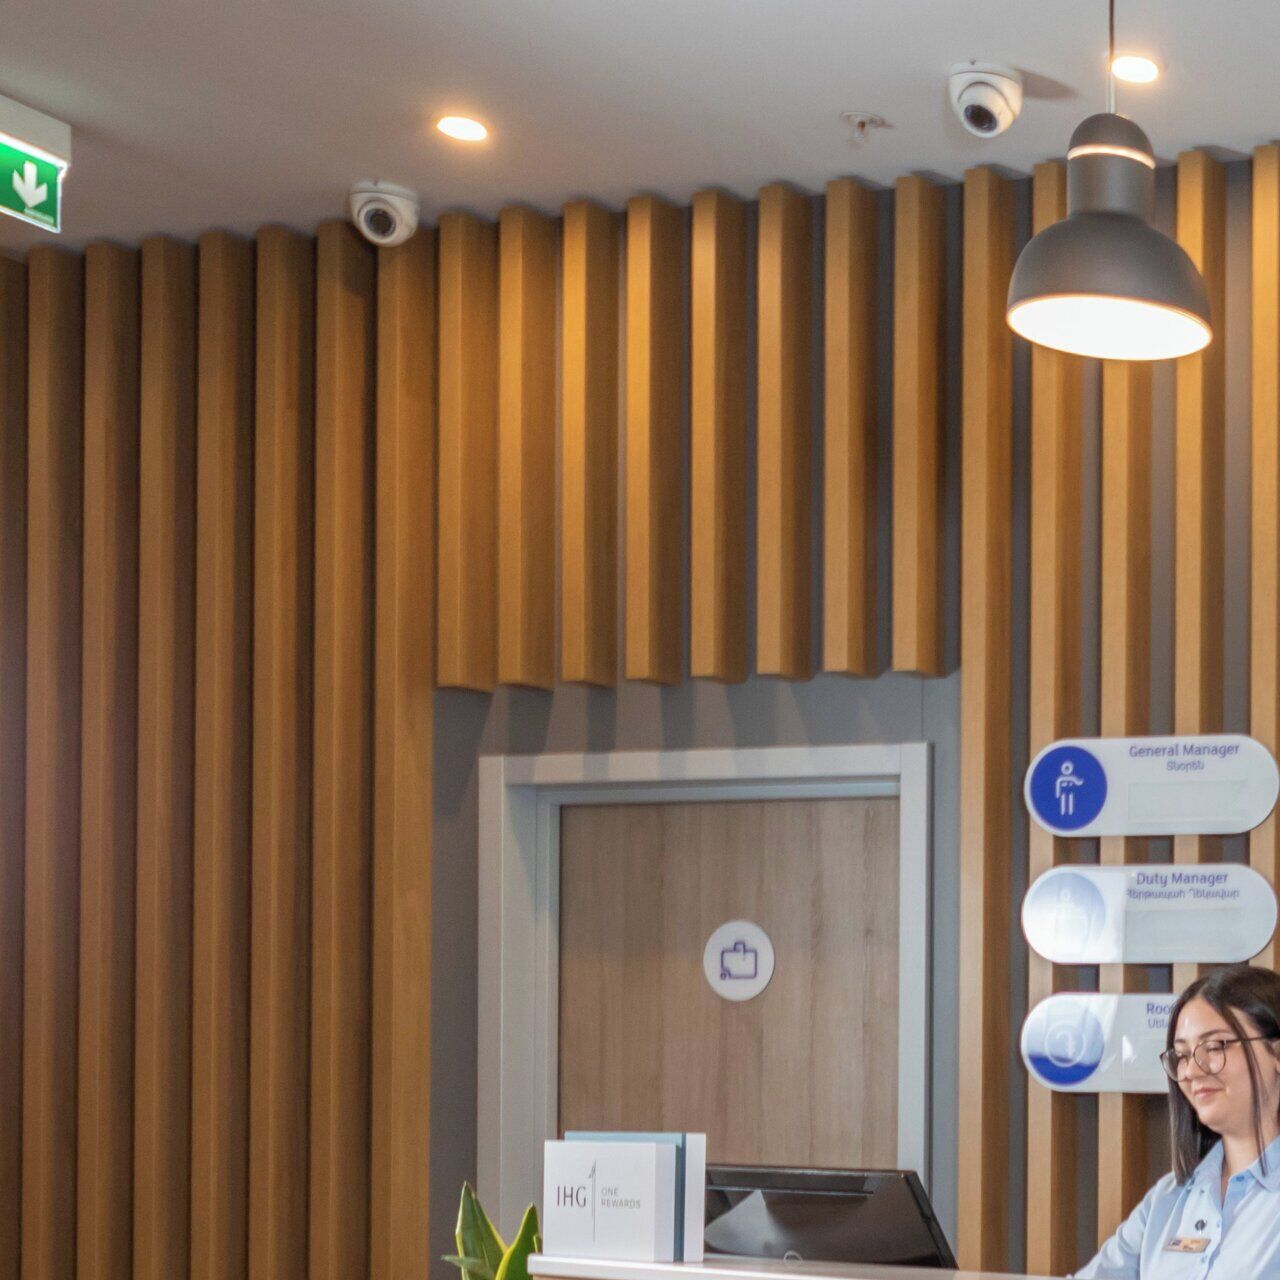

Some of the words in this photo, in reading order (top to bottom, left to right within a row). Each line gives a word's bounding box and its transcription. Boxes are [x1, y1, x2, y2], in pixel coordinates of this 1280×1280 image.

[1129, 744, 1179, 757] General
[1183, 744, 1239, 758] Manager
[1137, 872, 1168, 887] Duty
[1172, 873, 1228, 887] Manager
[1146, 1003, 1171, 1015] Roo
[557, 1185, 586, 1208] IHG
[601, 1187, 619, 1197] ONE
[601, 1199, 641, 1210] REWARDS
